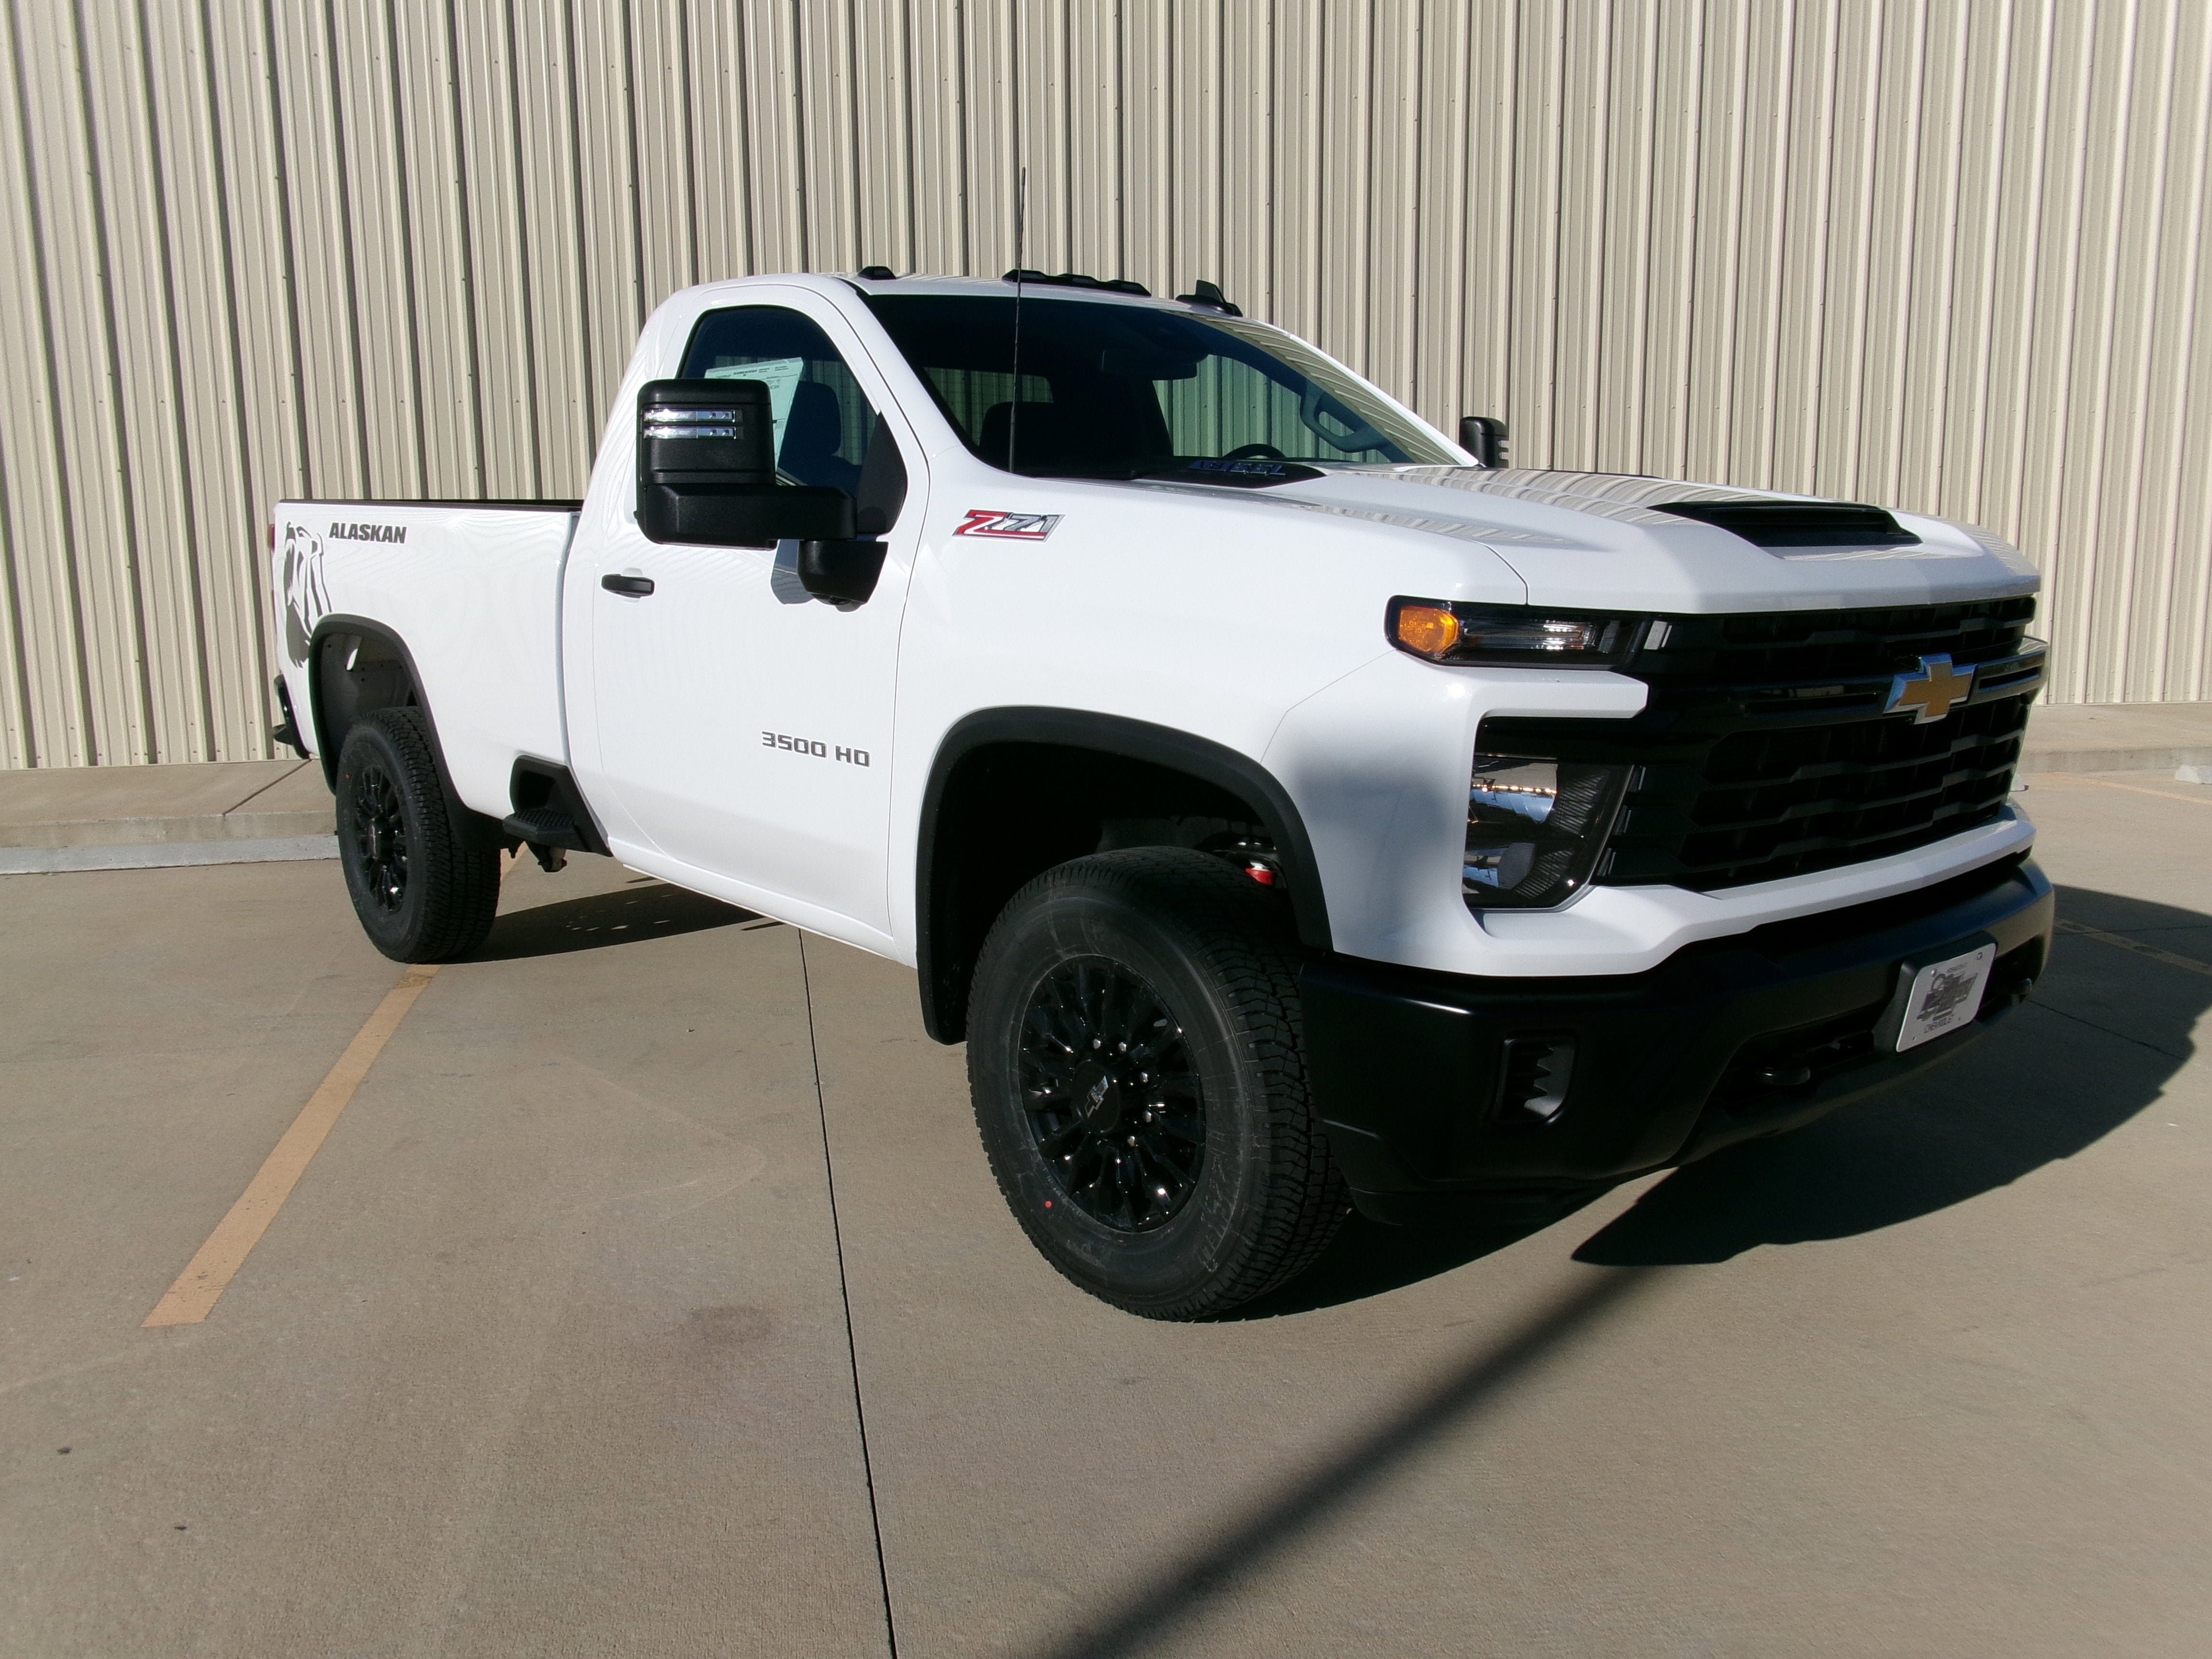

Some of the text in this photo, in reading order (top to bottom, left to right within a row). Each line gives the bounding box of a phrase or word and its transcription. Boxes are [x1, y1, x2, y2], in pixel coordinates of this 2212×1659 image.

[329, 522, 407, 543] ALASKAN
[953, 509, 1065, 542] Z71
[762, 731, 870, 767] 3500 HD
